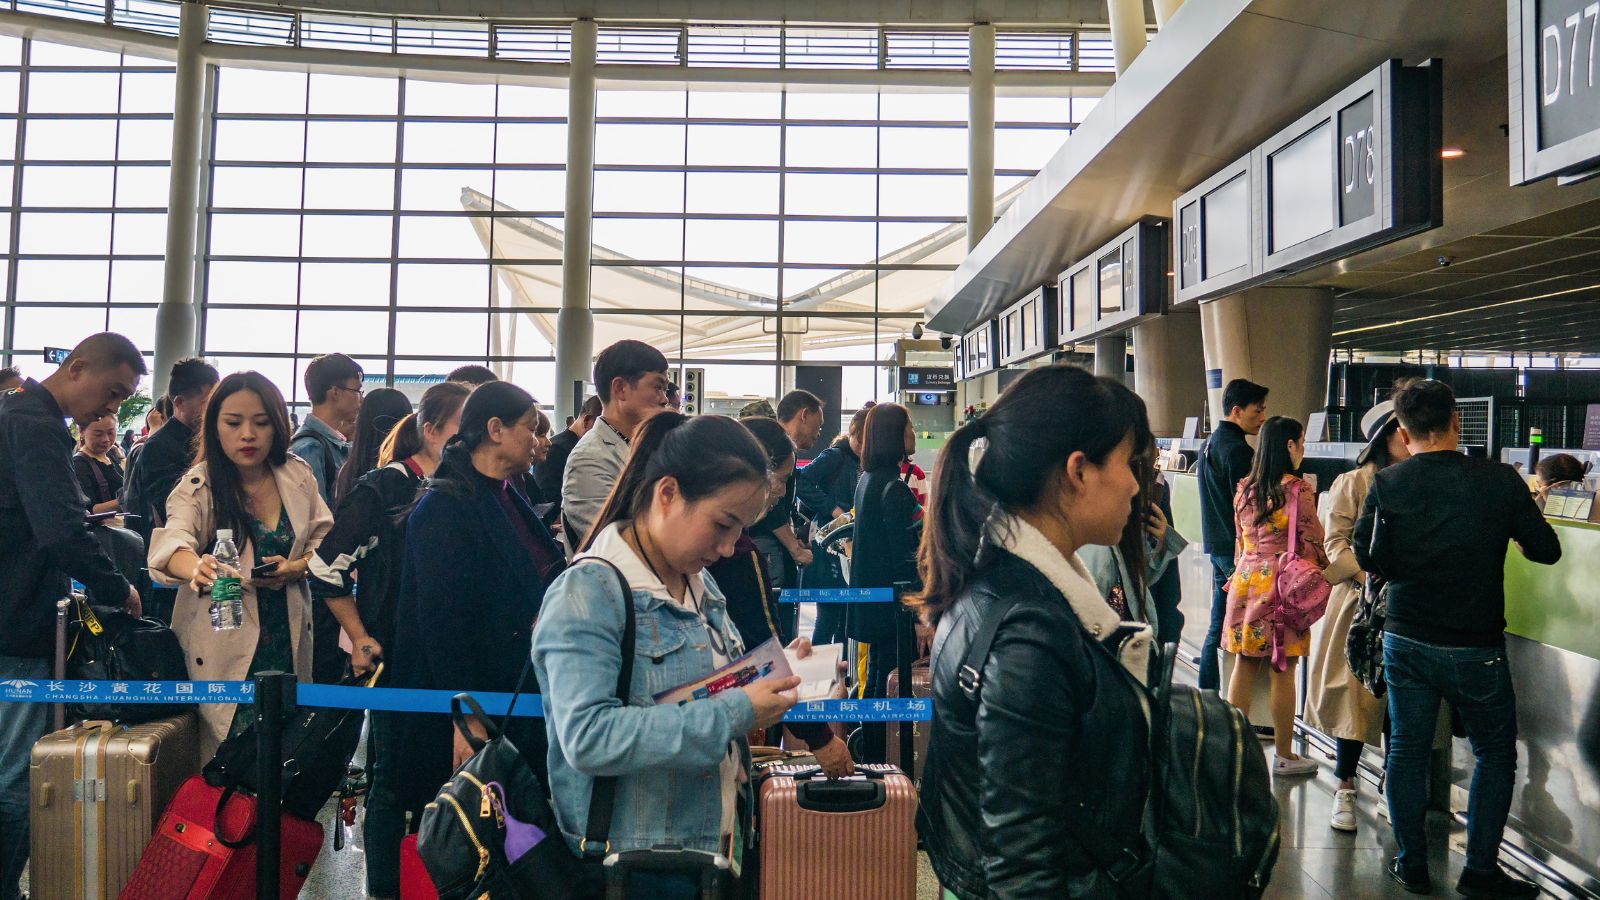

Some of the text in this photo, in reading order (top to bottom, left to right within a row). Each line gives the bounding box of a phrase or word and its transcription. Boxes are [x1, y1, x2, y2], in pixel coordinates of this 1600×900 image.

[1543, 1, 1600, 107] D77
[1344, 124, 1374, 194] D78
[788, 701, 926, 712] 国际机场
